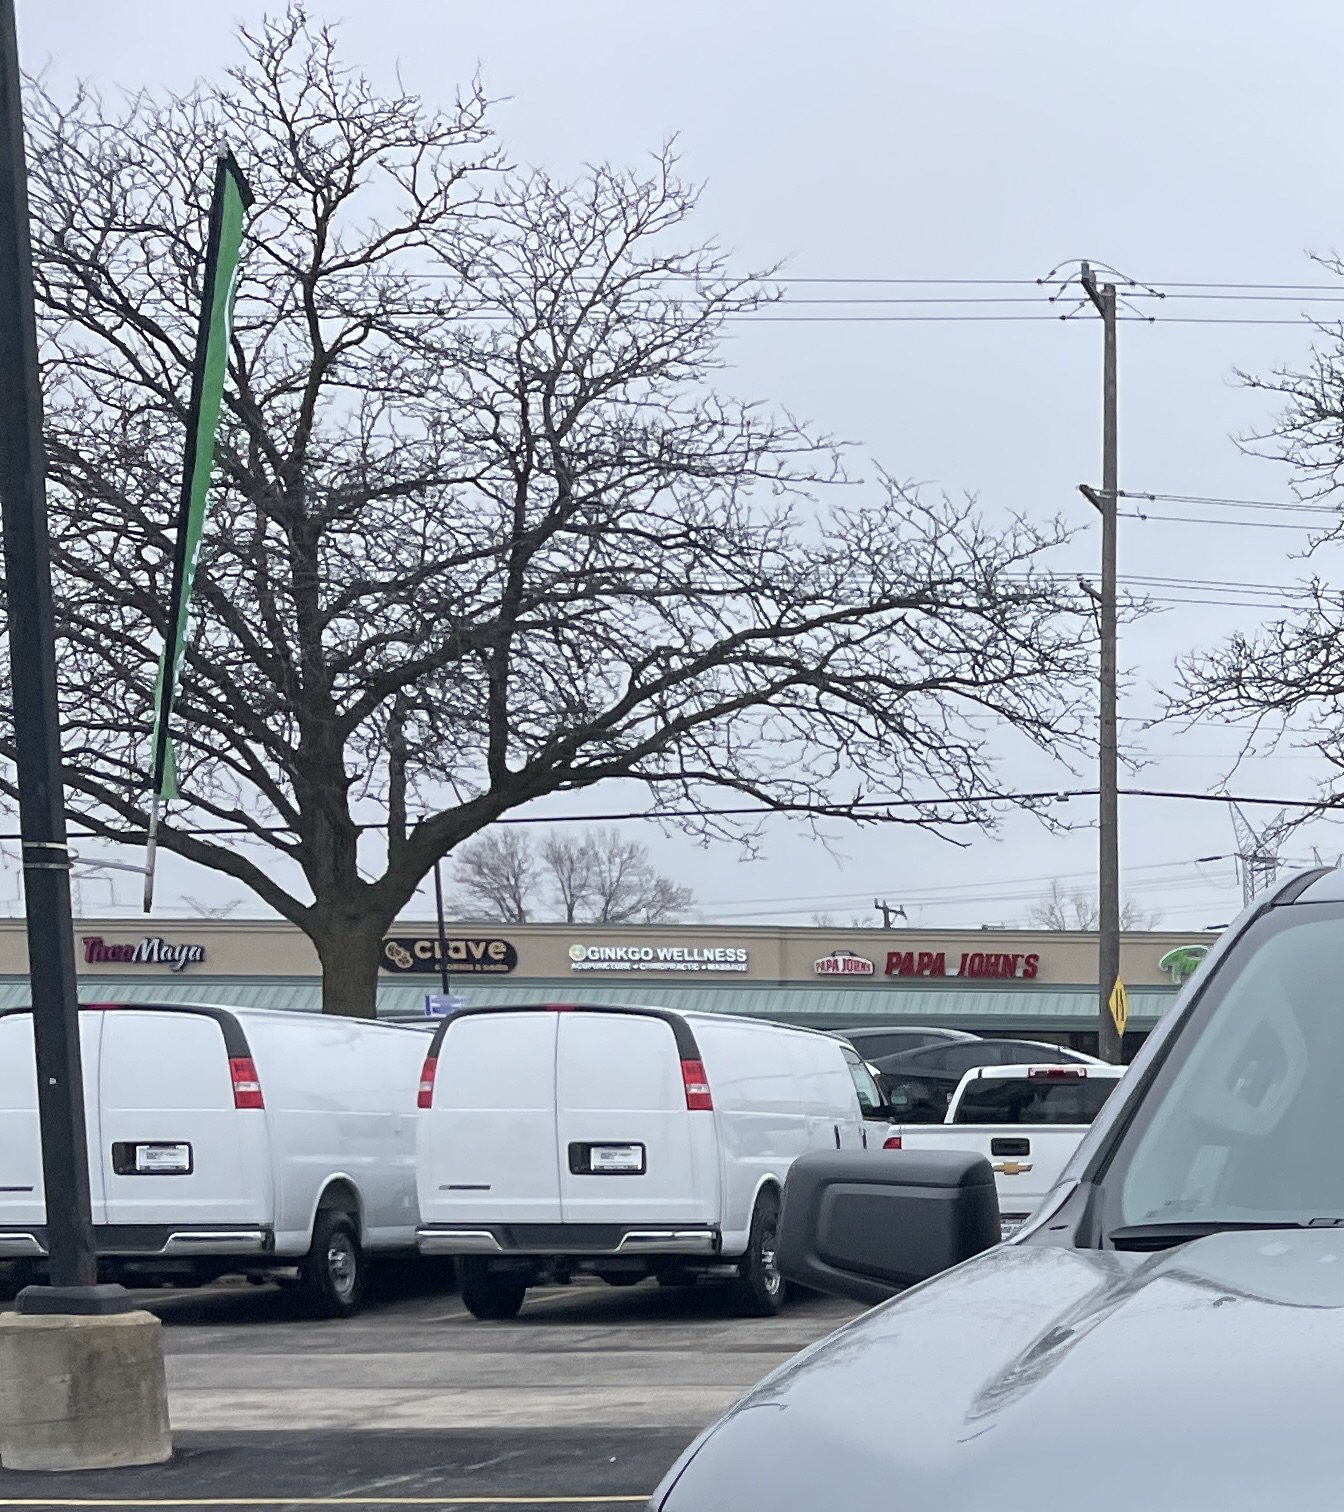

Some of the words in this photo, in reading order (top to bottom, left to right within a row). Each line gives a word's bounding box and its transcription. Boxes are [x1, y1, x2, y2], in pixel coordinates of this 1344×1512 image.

[587, 946, 653, 961] GINKGO
[654, 947, 748, 962] WELLNESS
[815, 958, 840, 973] PAPA
[885, 951, 947, 977] PAPA
